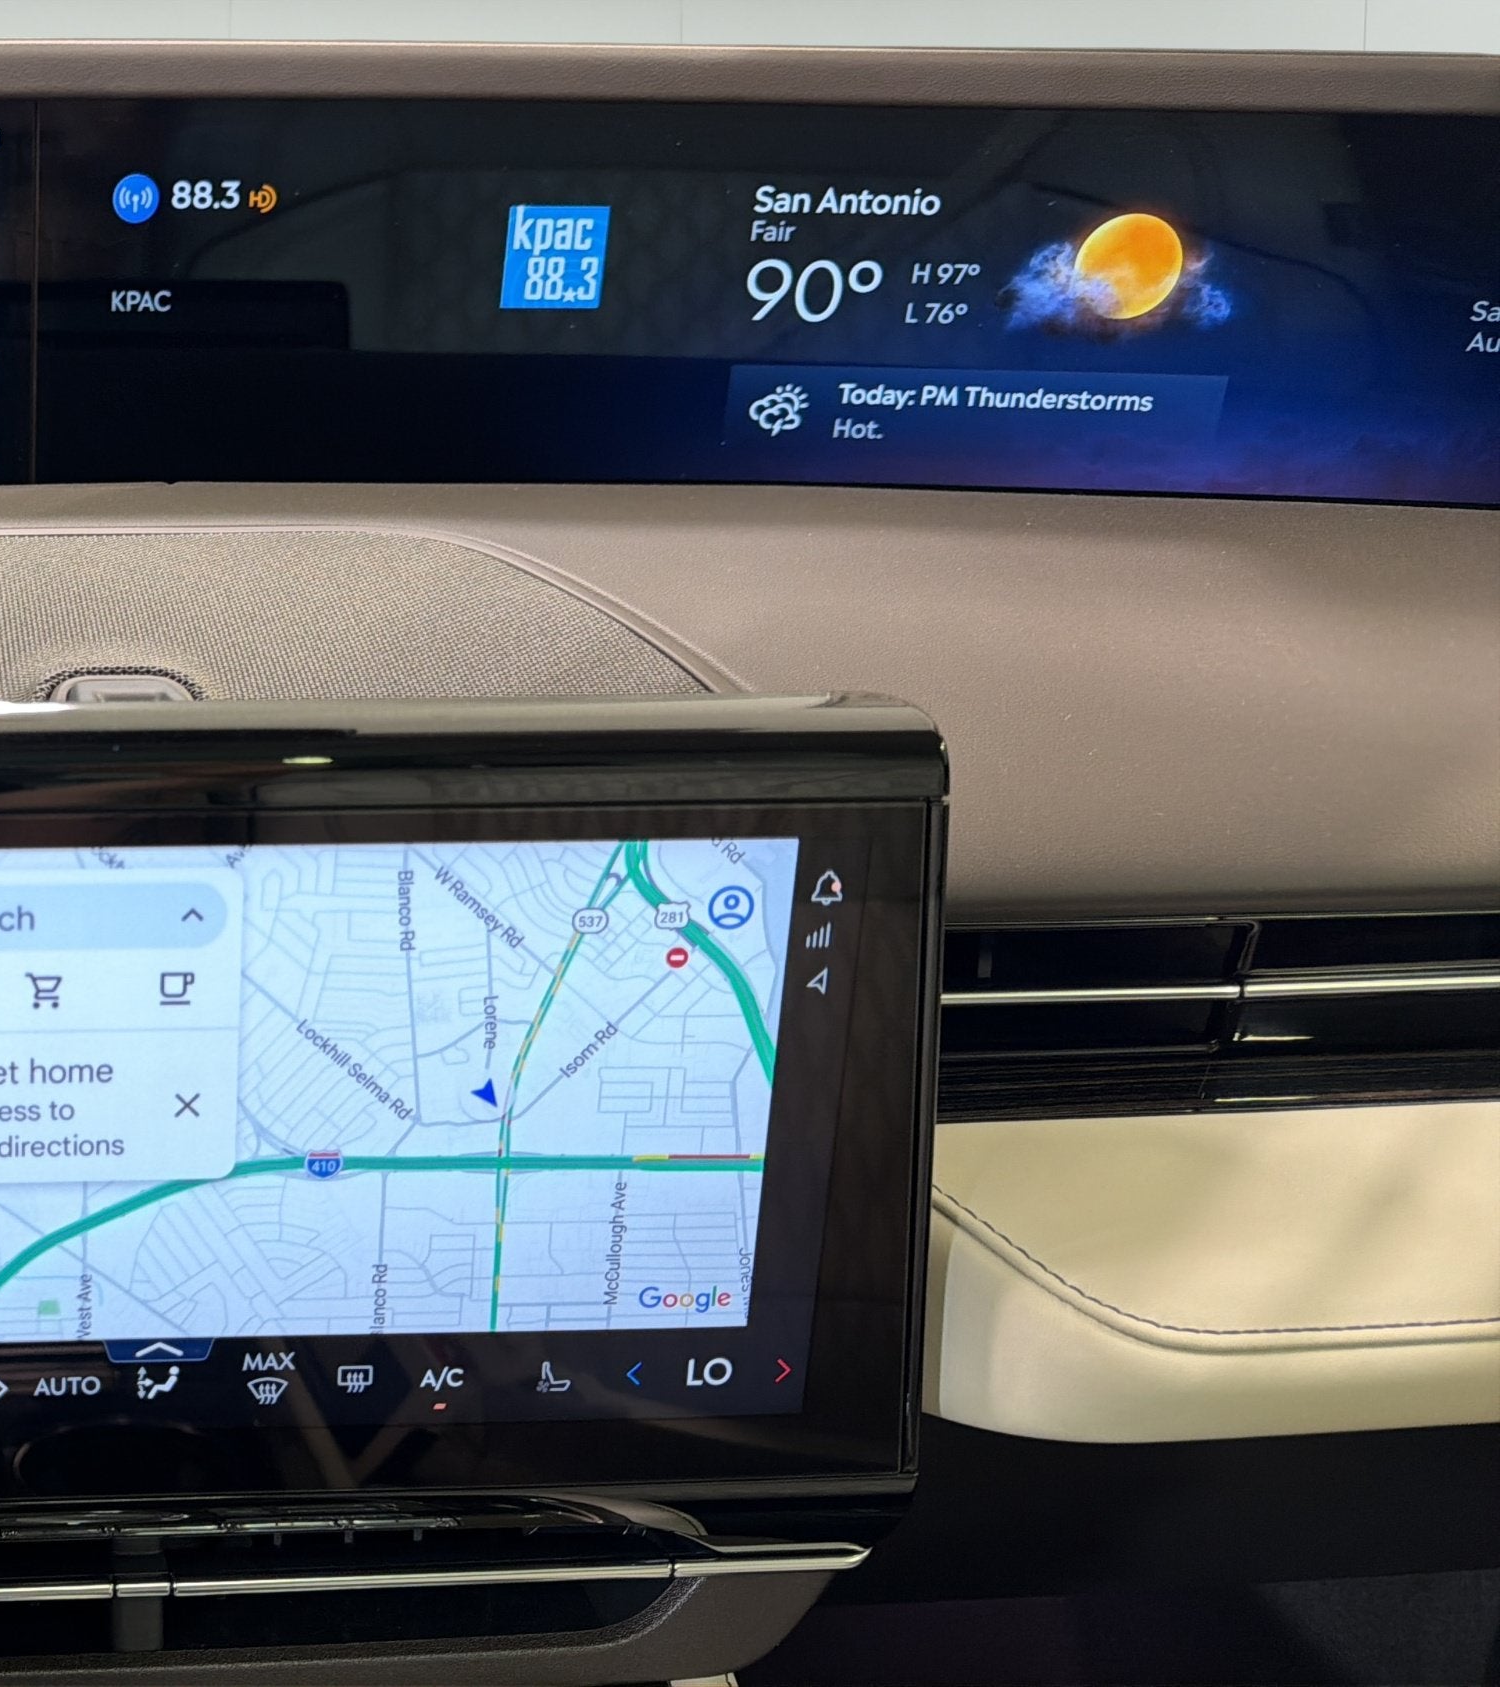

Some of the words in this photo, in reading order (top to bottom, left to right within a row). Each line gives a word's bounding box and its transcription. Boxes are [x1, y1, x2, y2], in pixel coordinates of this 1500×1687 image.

[171, 180, 241, 210] 88.3
[753, 185, 811, 214] San
[816, 186, 941, 216] Antonio
[513, 205, 593, 255] kpac
[750, 220, 797, 243] Fair
[911, 263, 931, 284] H
[110, 290, 172, 313] KPAC
[905, 303, 919, 324] L
[838, 383, 916, 410] Today:
[920, 385, 958, 408] PM
[964, 386, 1154, 413] Thunderstorms
[832, 418, 884, 440] Hot.
[397, 870, 414, 927] Blanco
[434, 866, 453, 886] W
[448, 877, 503, 933] Ramsey
[499, 926, 525, 949] Rd
[578, 915, 604, 929] 537
[660, 911, 685, 925] 281
[399, 929, 416, 952] Rd
[483, 995, 500, 1050] Lorene
[559, 1041, 598, 1079] Isom
[593, 1021, 619, 1047] Rd
[29, 1058, 114, 1084] home
[296, 1018, 351, 1070] Lockhill
[348, 1061, 394, 1105] Selma
[388, 1097, 414, 1121] Rd
[49, 1102, 75, 1122] to
[311, 1160, 338, 1173] 410
[610, 1182, 628, 1211] Ave
[603, 1213, 628, 1306] McCullough
[739, 1247, 753, 1293] Jones
[372, 1264, 388, 1284] Rd
[76, 1274, 92, 1302] Ave
[639, 1285, 731, 1313] Google
[242, 1351, 296, 1372] MAX
[686, 1357, 733, 1386] LO
[34, 1376, 101, 1397] AUTO
[420, 1366, 464, 1388] A/C
